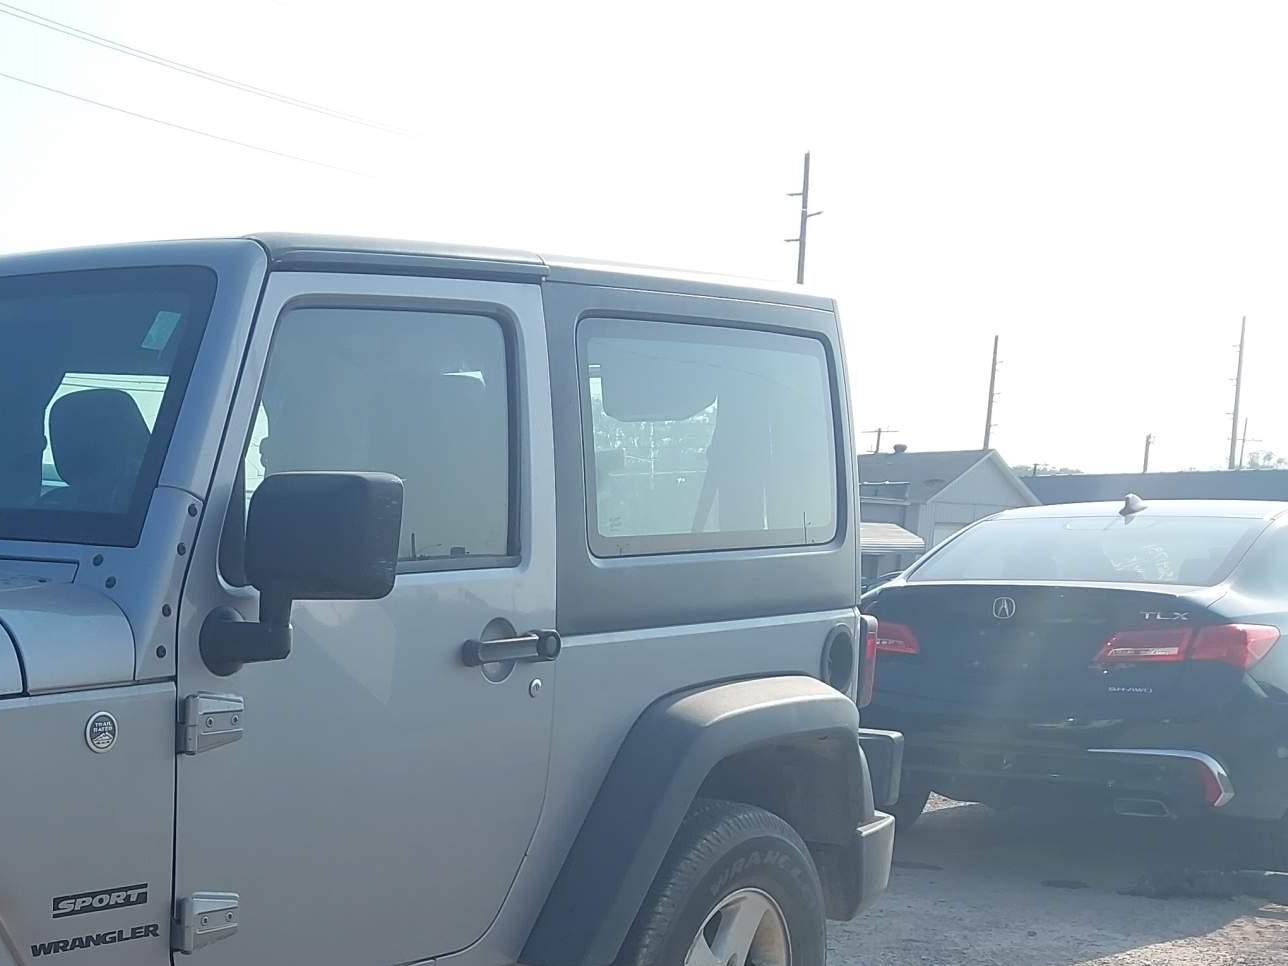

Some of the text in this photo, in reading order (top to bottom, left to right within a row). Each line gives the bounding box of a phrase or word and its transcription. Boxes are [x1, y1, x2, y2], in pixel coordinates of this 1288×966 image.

[1141, 612, 1190, 620] TLX
[57, 890, 147, 914] SPORT
[30, 924, 159, 957] WRANGLER
